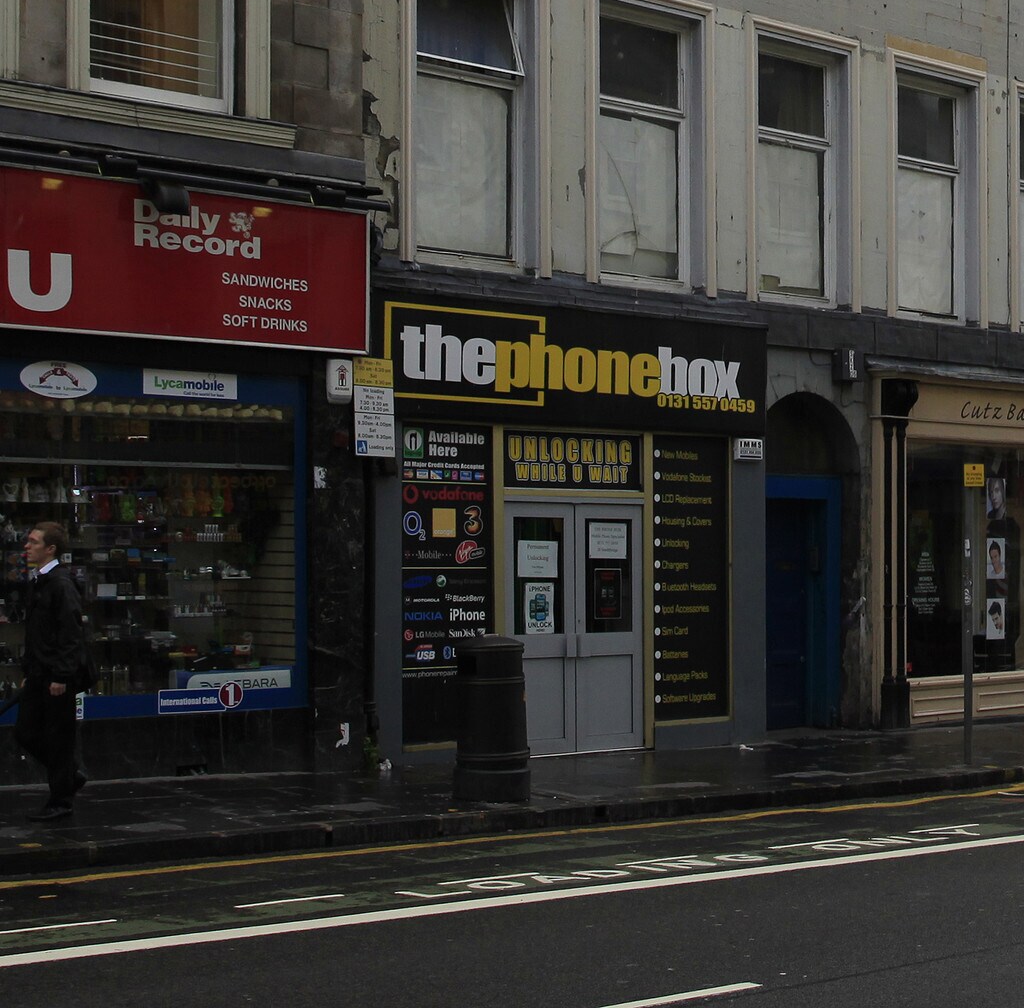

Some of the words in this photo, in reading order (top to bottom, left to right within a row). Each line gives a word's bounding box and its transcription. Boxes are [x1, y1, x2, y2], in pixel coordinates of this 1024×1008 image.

[134, 198, 220, 235] Daily
[134, 223, 261, 259] Record
[8, 249, 72, 312] U
[222, 272, 308, 292] SANDWICHES
[239, 295, 292, 312] SNACKS
[223, 314, 257, 328] SOFT
[261, 317, 308, 333] DRINKS
[154, 376, 224, 391] Lycamobile
[656, 394, 689, 410] 0131
[691, 395, 718, 411] 557
[719, 398, 756, 414] 0459
[960, 401, 1002, 419] Cutz
[428, 430, 485, 445] Available
[428, 443, 458, 458] Here
[508, 434, 633, 466] UNLOCKING
[661, 449, 675, 459] New
[675, 450, 699, 461] Mobiles
[427, 461, 444, 469] Credit
[515, 462, 567, 483] WHILE
[572, 464, 583, 483] U
[588, 464, 628, 484] WAIT
[661, 472, 688, 482] Vodafone
[422, 486, 485, 502] vodafone
[661, 494, 674, 504] LCD
[675, 494, 712, 505] Replacement
[463, 505, 484, 536] 3
[661, 516, 685, 528] Housing
[686, 517, 691, 526] &
[692, 516, 712, 526] Covers
[661, 538, 689, 550] Unlocking
[661, 560, 689, 572] Chargers
[662, 582, 689, 592] Buetooth
[689, 582, 717, 591] Headsets
[452, 594, 485, 603] BlackBerry
[404, 611, 444, 621] NOKIA
[449, 608, 486, 621] iPhone
[675, 604, 710, 614] Accessories
[415, 631, 425, 639] LG
[448, 628, 476, 639] SanDisk
[662, 626, 674, 636] Sim
[674, 625, 689, 636] Card
[416, 650, 436, 660] USB
[236, 677, 278, 688] BARA
[662, 672, 690, 683] Language
[690, 670, 709, 680] Packs
[160, 697, 201, 707] International
[202, 696, 218, 706] Calls
[662, 693, 689, 704] Software
[689, 692, 717, 704] Upgrades
[395, 853, 769, 898] LOADING
[811, 826, 981, 852] ONLY
